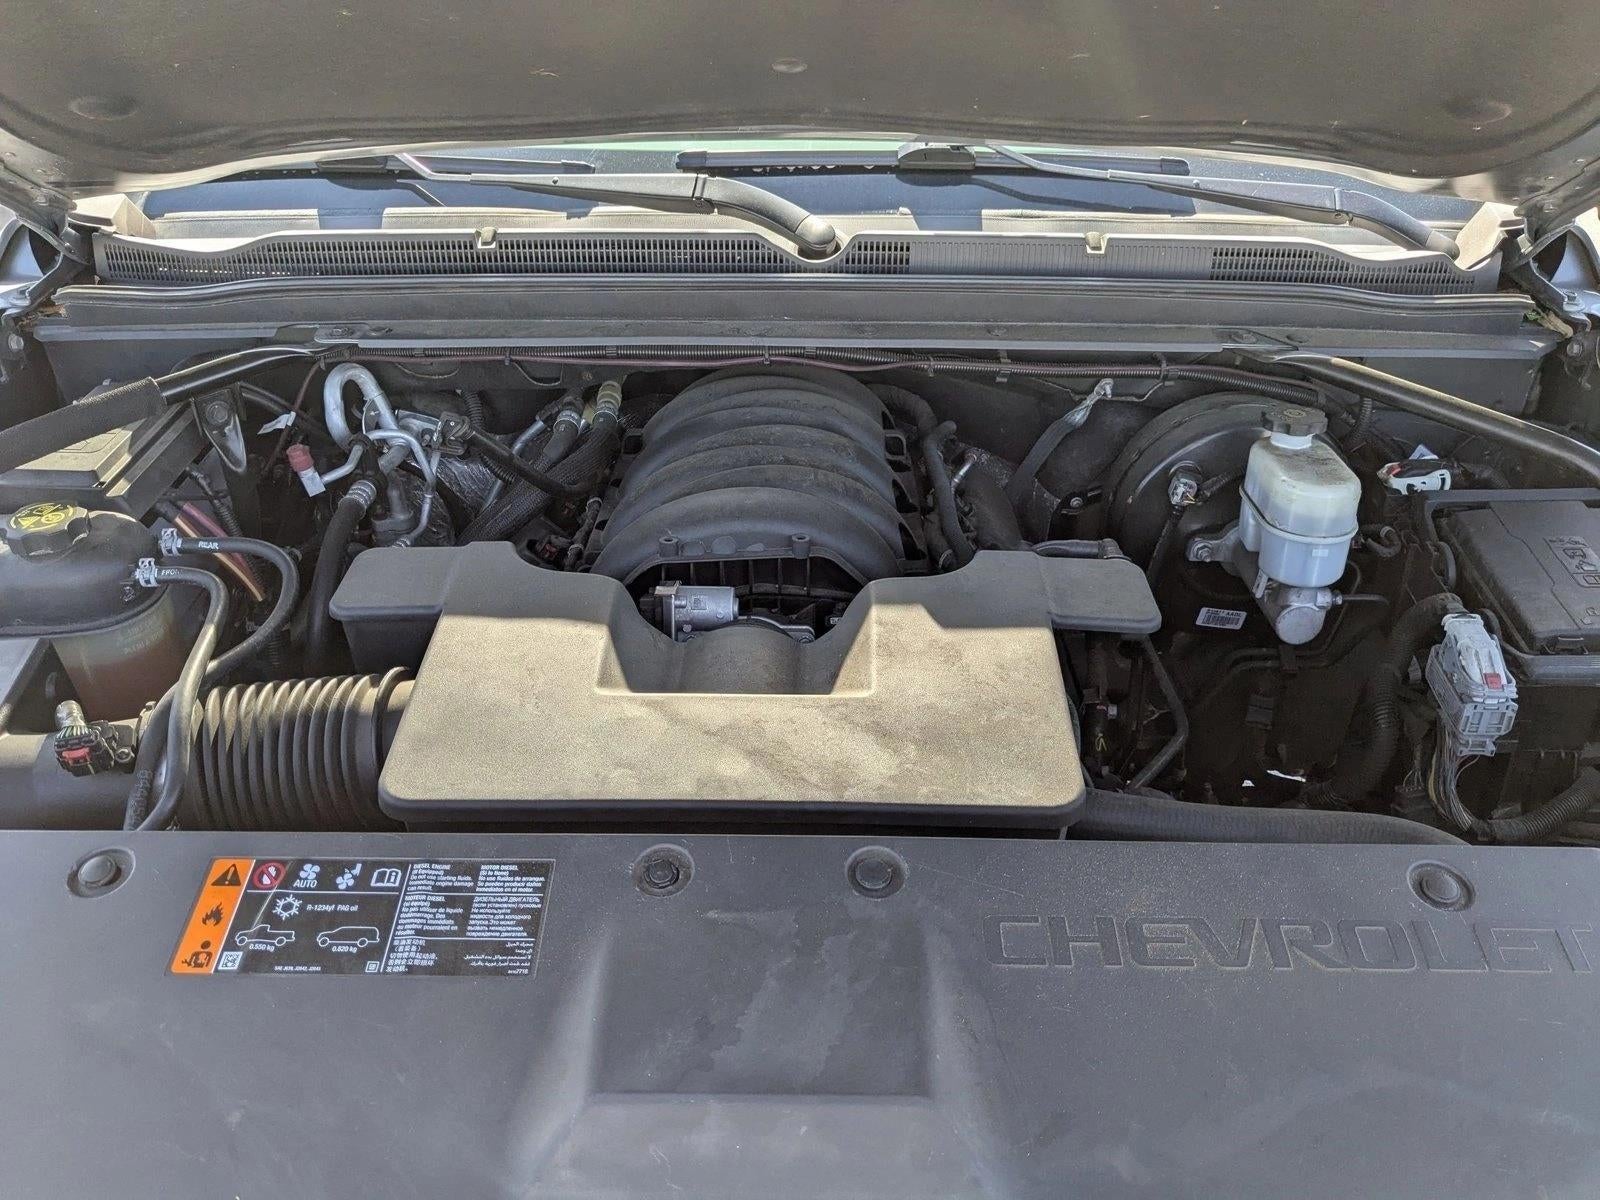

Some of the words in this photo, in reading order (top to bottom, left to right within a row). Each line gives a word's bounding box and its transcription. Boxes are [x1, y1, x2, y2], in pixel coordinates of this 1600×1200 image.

[198, 541, 219, 550] REAR
[294, 880, 318, 888] AUTO
[306, 904, 335, 912] R-1234yf
[982, 914, 1594, 973] CHEVROLET
